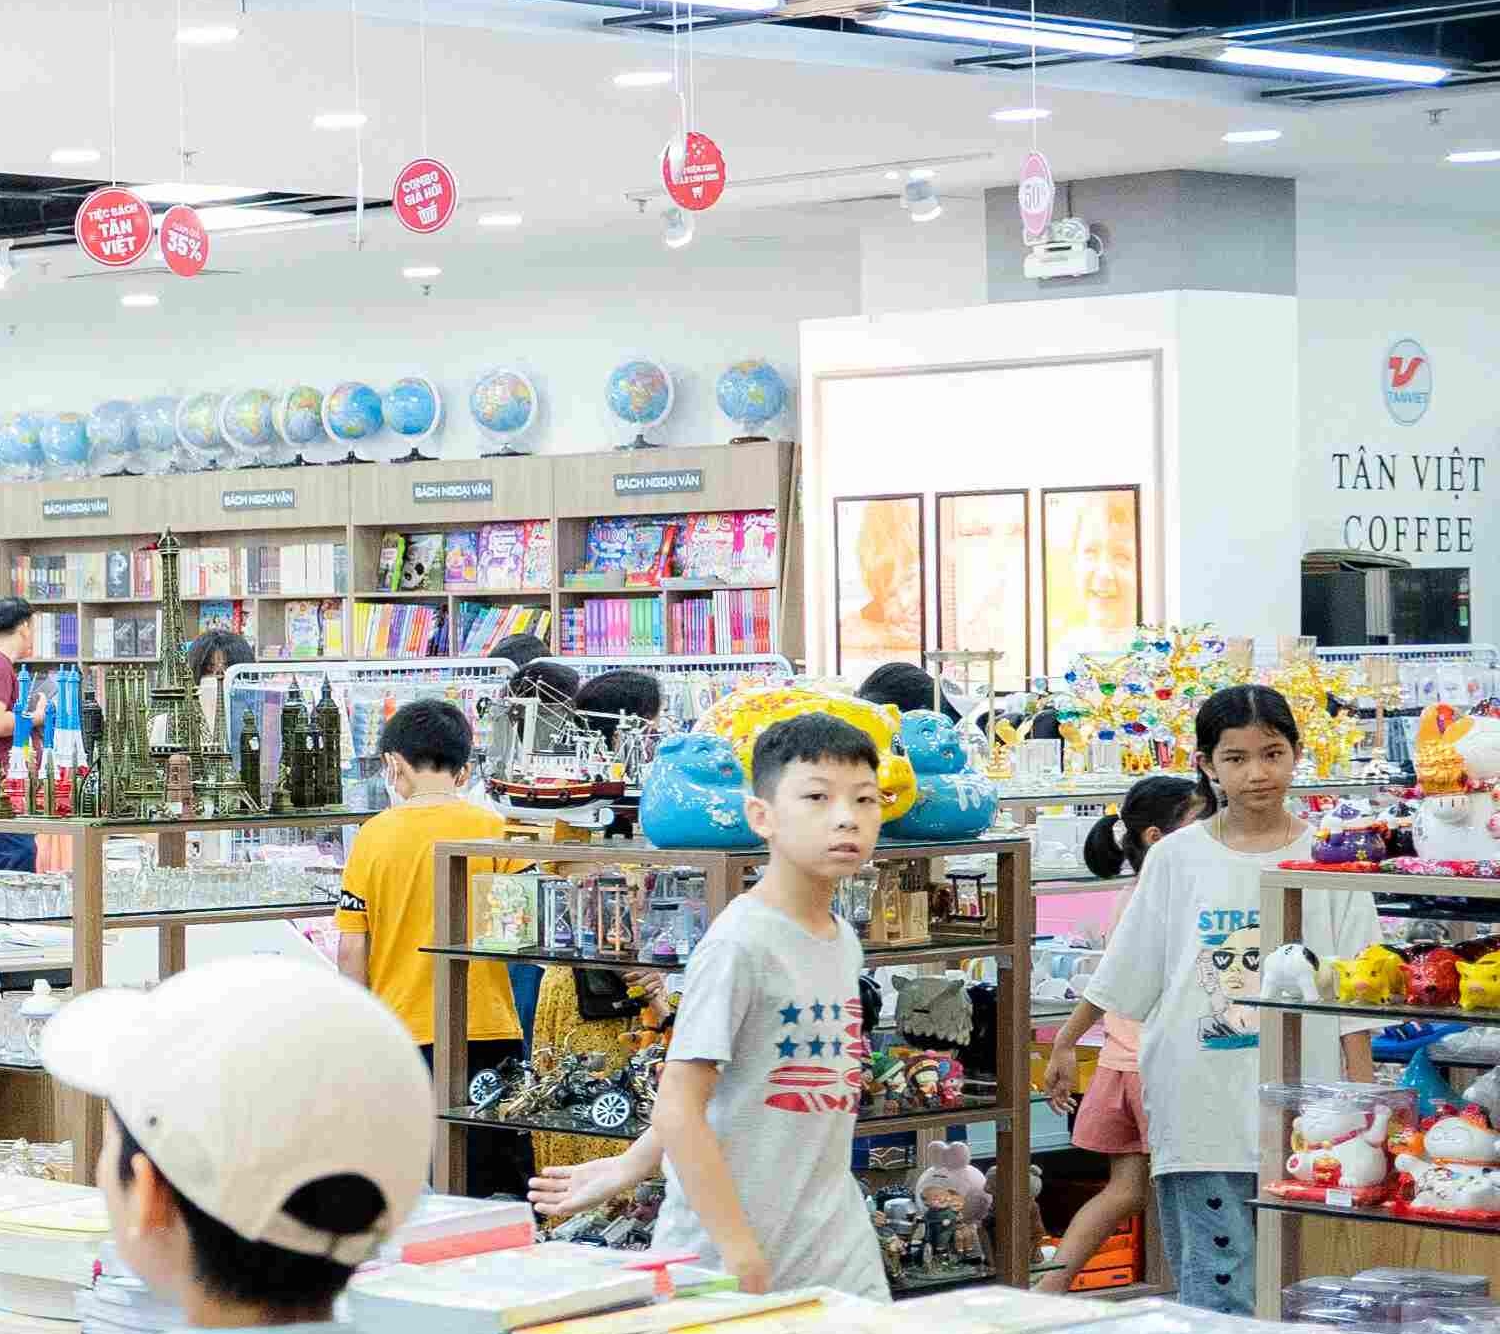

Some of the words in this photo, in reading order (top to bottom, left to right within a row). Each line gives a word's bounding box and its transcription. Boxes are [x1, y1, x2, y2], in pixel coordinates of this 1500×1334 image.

[98, 218, 133, 238] TÂN
[166, 228, 203, 262] 35%
[100, 235, 137, 256] VIỆT
[1332, 444, 1397, 490] TÂN
[1411, 445, 1485, 500] VIỆT
[1343, 514, 1474, 553] COFFEE
